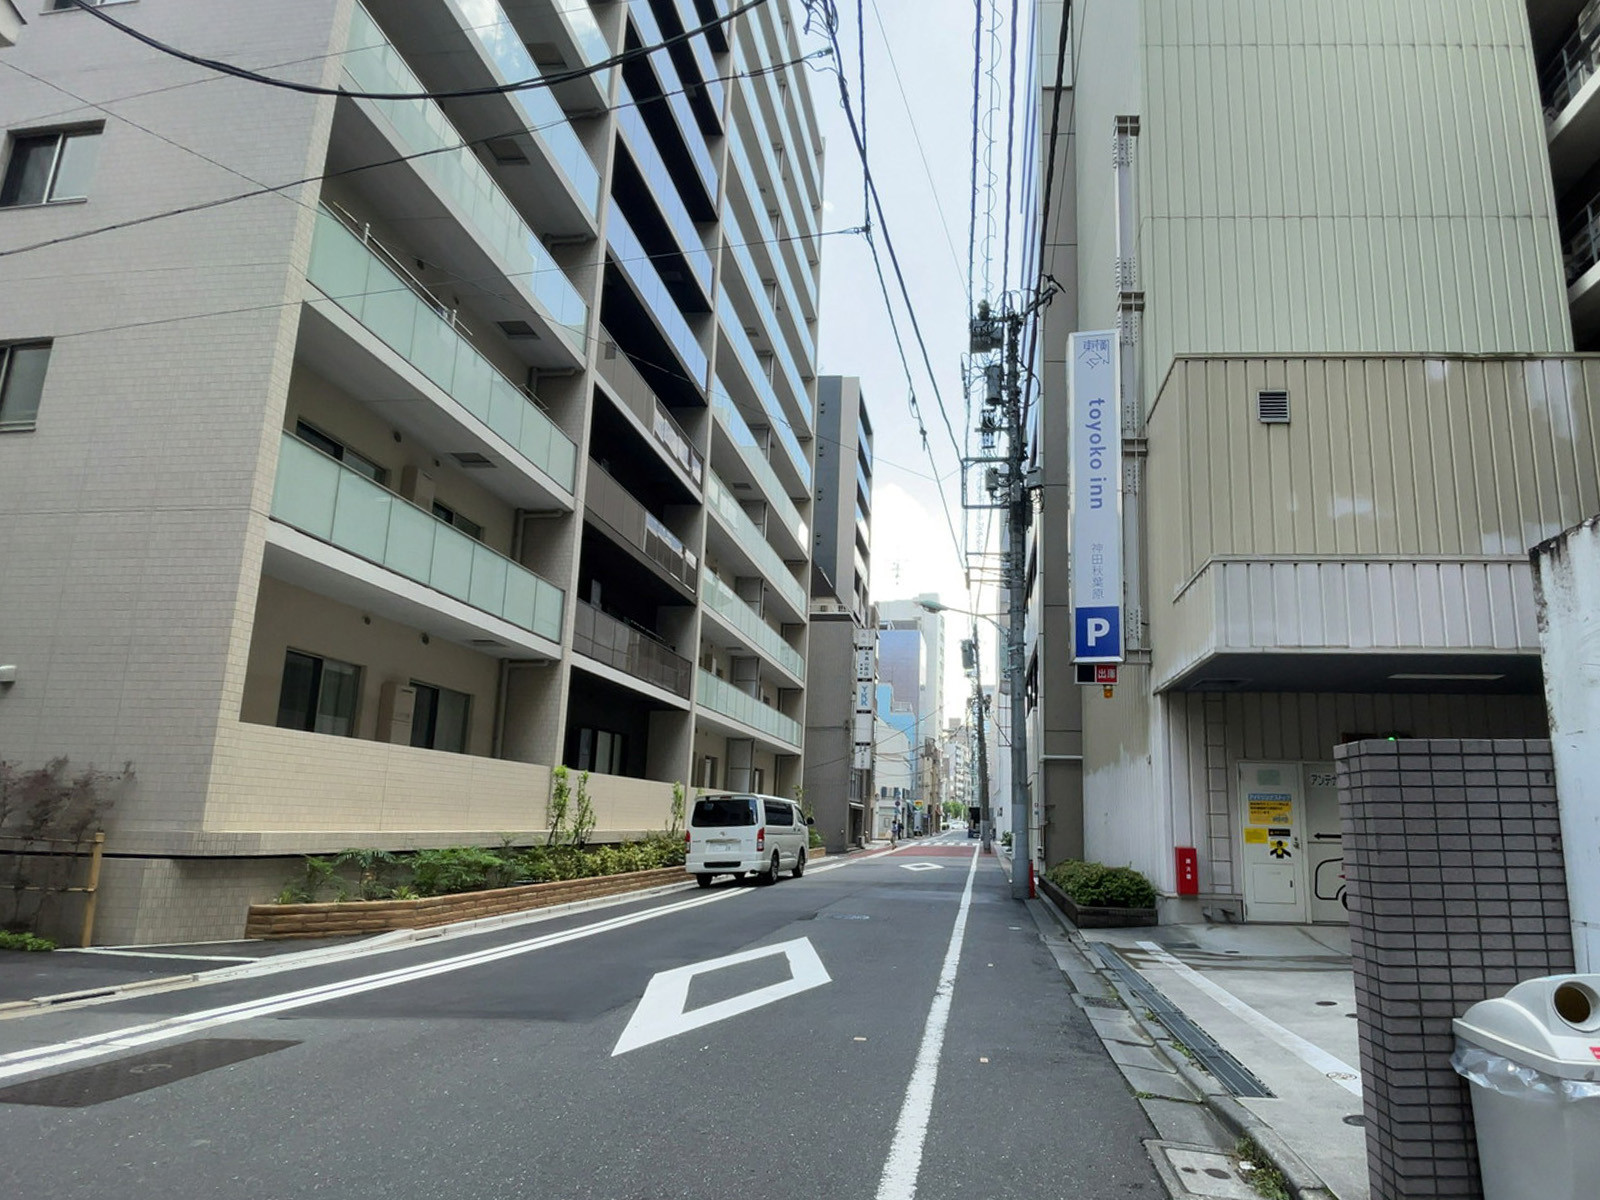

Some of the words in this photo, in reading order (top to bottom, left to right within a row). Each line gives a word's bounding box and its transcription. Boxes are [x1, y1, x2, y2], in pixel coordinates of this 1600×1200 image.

[1085, 398, 1106, 470] toyoko
[1090, 477, 1107, 509] inn
[1091, 543, 1104, 600] 神田秋葉原
[1087, 617, 1110, 647] P
